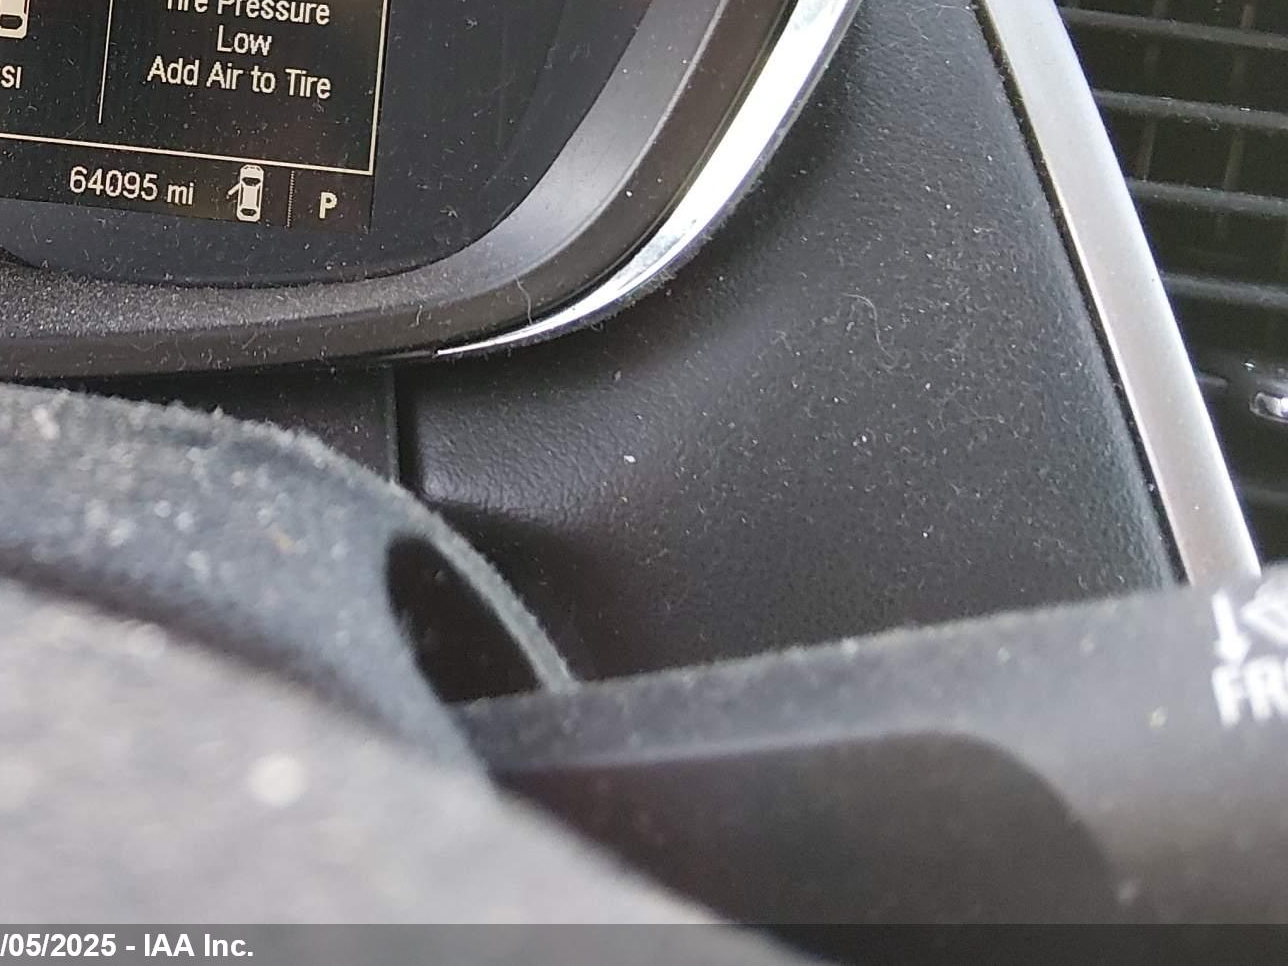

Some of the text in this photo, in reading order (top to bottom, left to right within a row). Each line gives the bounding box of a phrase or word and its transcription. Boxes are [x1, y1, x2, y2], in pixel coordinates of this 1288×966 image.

[217, 25, 273, 57] Low
[148, 55, 331, 100] Add Air to Tire
[69, 166, 194, 206] 64095 mi
[318, 191, 338, 219] P
[1212, 656, 1288, 728] FR
